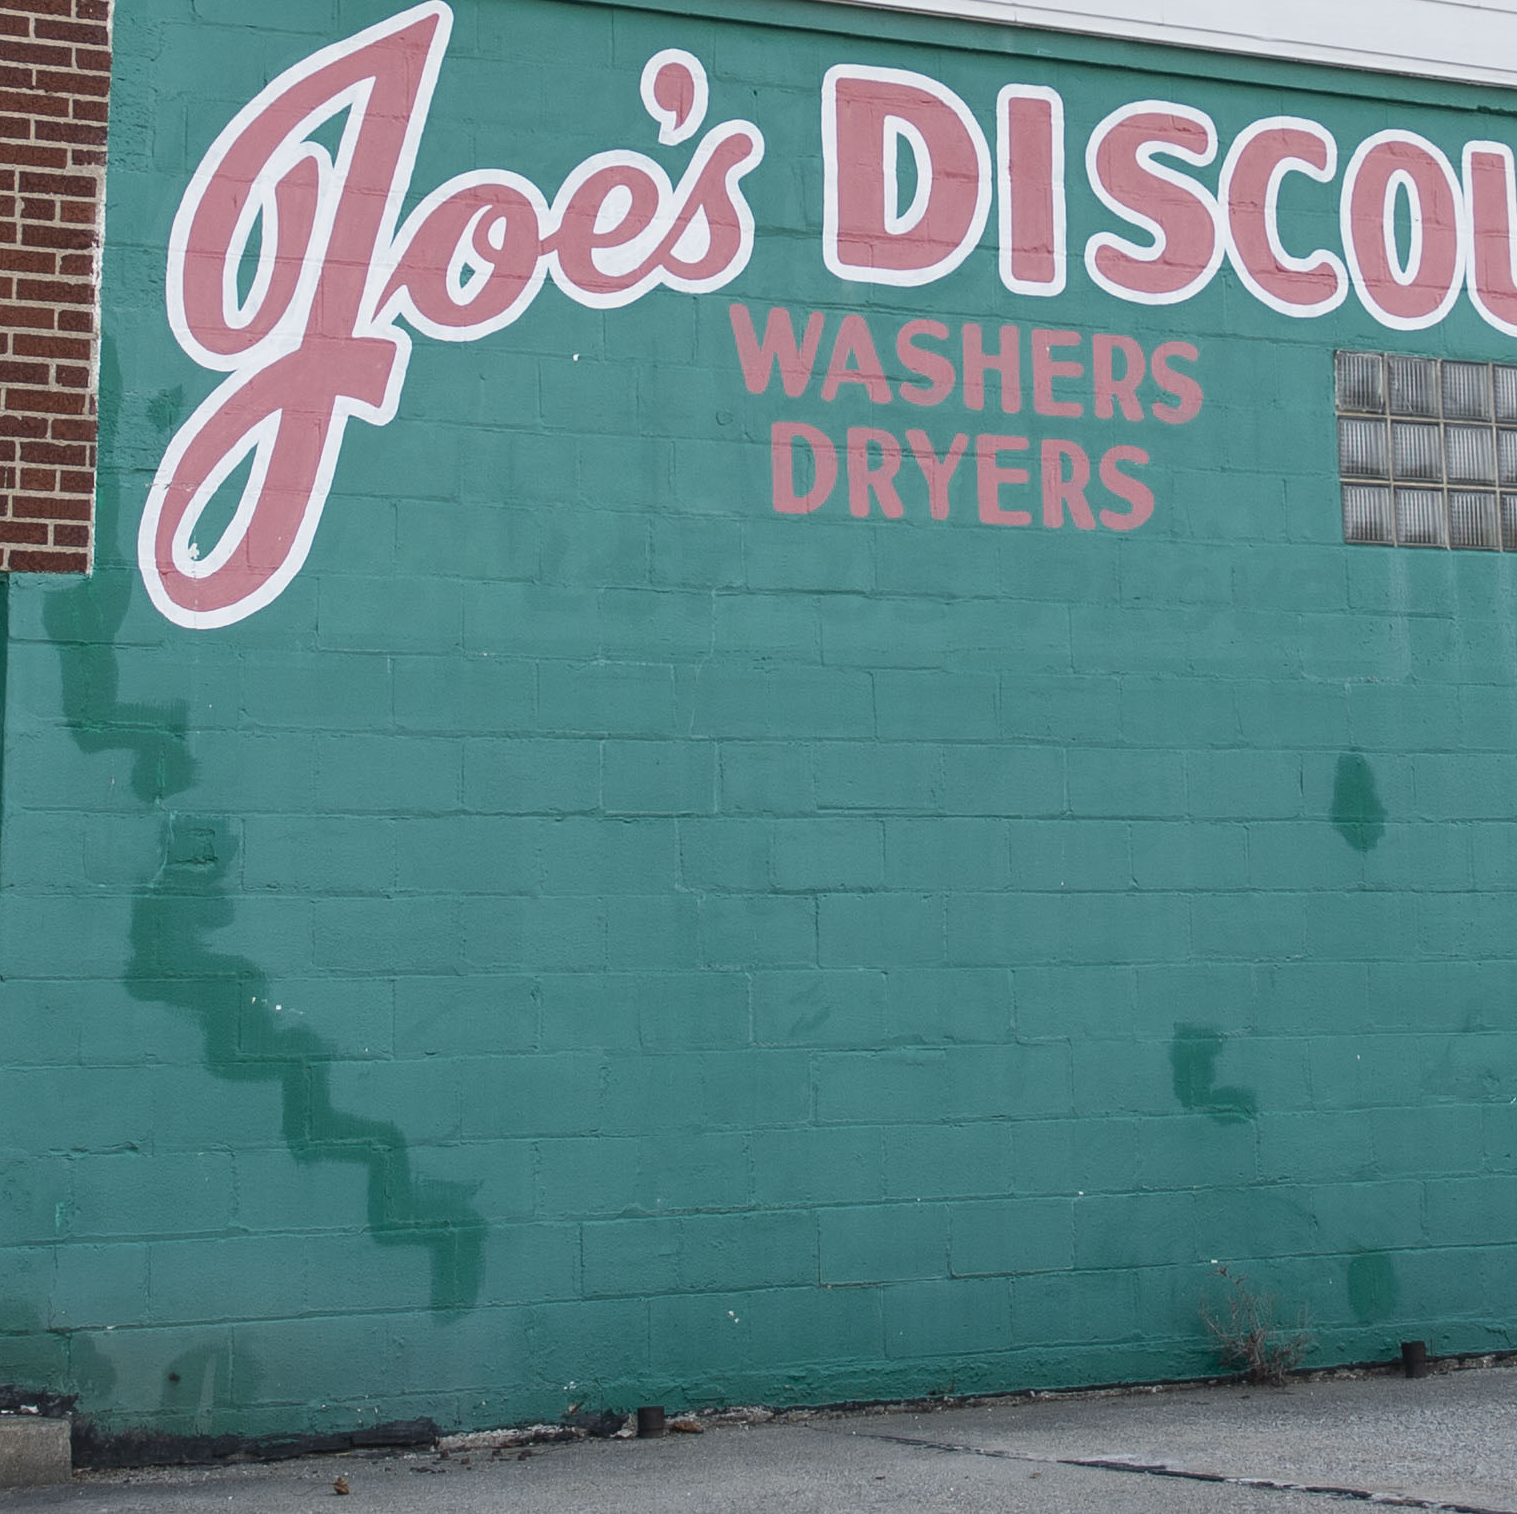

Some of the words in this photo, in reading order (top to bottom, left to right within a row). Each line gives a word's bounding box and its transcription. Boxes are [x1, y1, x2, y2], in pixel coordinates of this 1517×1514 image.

[137, 0, 765, 630] Joe's
[729, 301, 1204, 425] WASHERS
[770, 420, 1156, 531] DRYERS
